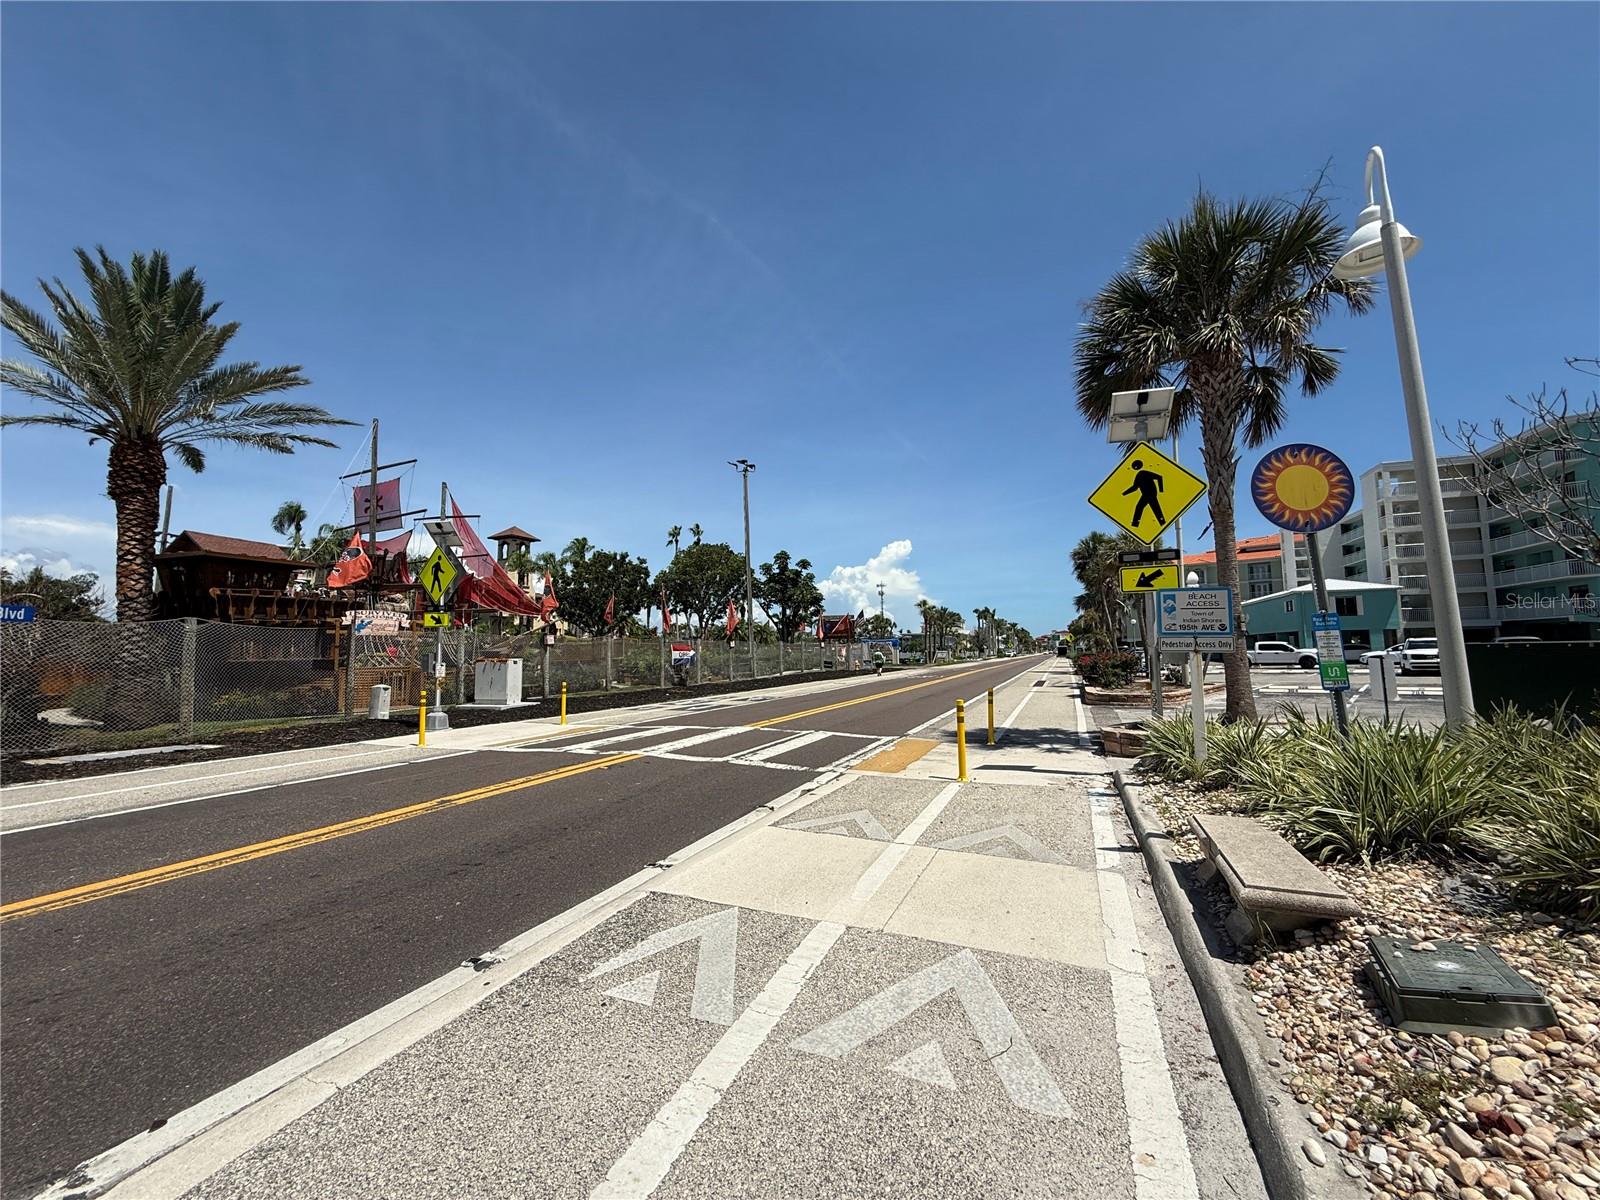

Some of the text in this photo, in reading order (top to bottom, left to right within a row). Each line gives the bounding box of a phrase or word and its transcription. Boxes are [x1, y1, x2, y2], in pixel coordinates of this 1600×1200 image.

[0, 606, 25, 620] Blvd
[1161, 640, 1232, 648] Pedestrian Access Only
